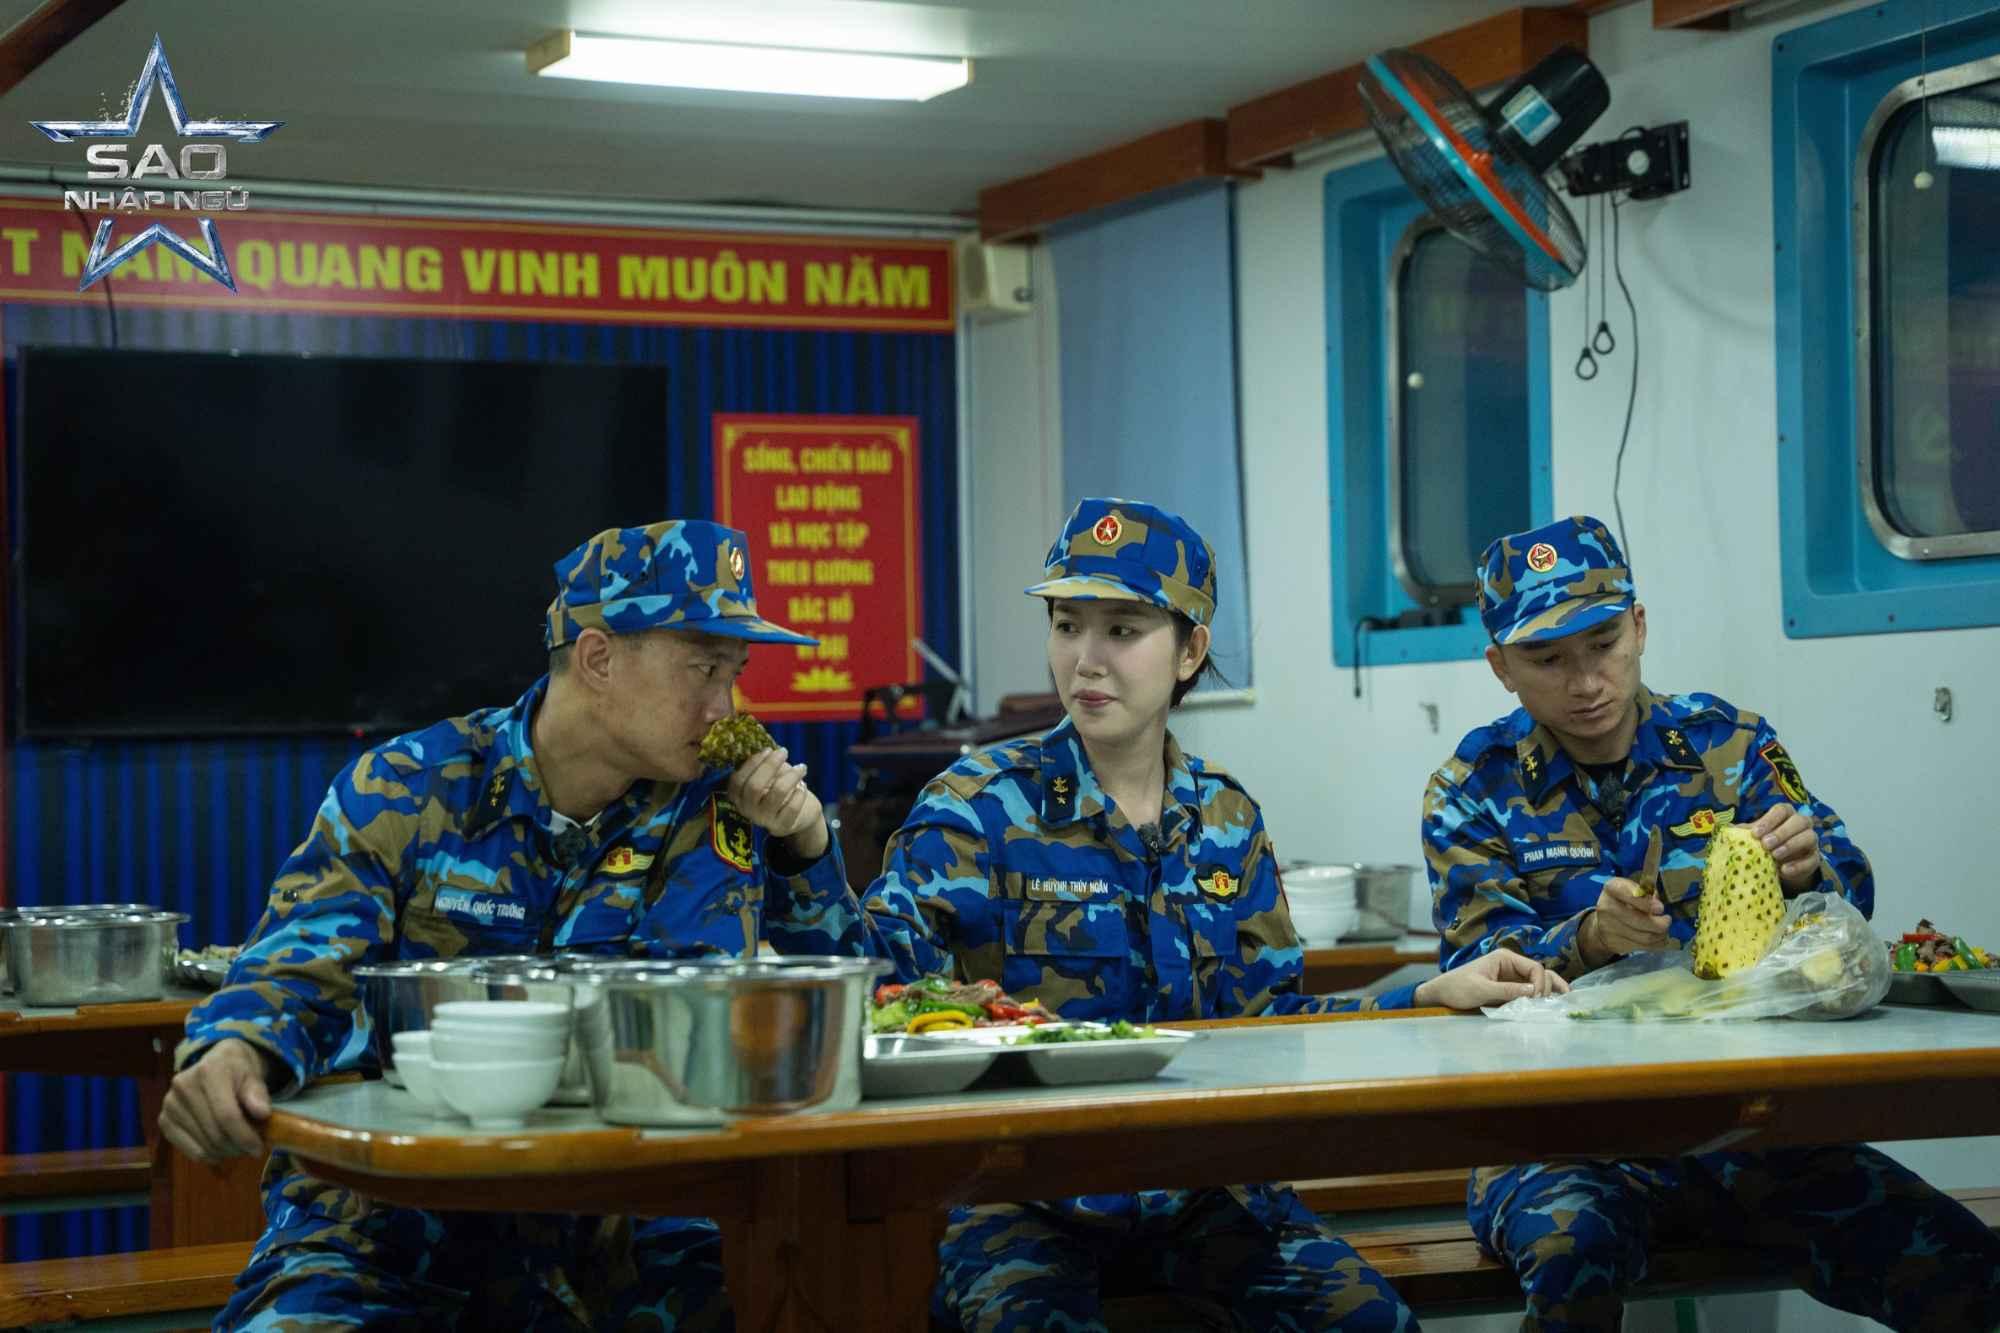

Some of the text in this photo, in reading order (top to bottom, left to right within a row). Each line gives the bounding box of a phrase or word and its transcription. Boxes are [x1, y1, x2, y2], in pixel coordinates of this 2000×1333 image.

[237, 239, 443, 292] QUANG
[461, 248, 599, 298] VINH
[617, 251, 787, 304] MUÔN
[804, 256, 930, 308] NĂM
[1523, 848, 1544, 863] PHAN
[1031, 877, 1041, 892] LÊ
[472, 898, 496, 915] QUỐC
